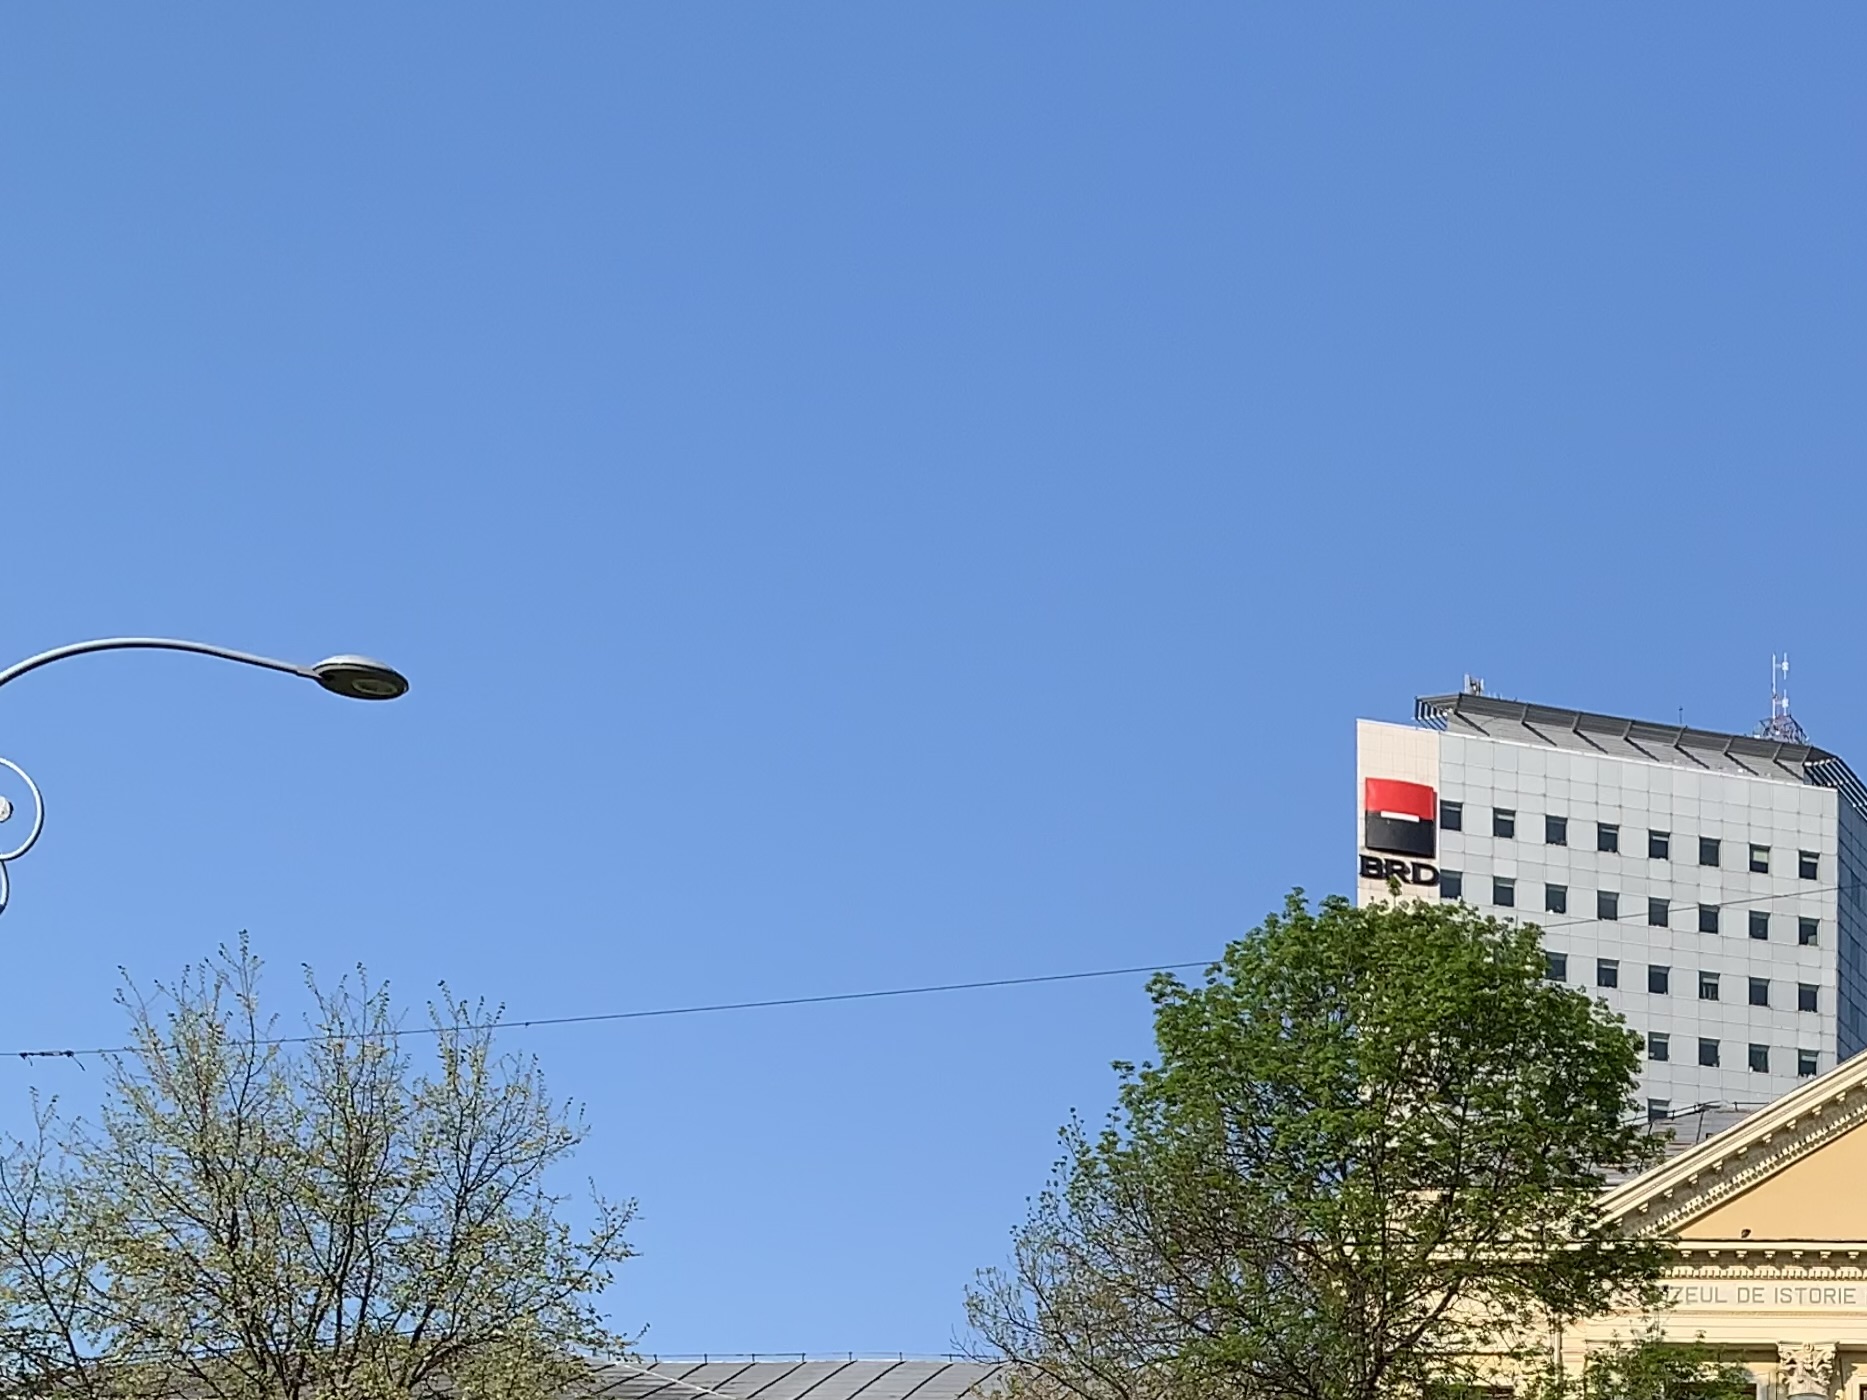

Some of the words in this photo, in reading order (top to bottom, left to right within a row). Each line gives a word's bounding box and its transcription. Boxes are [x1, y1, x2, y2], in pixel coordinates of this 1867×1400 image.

[1359, 854, 1440, 886] BRD
[1664, 1285, 1728, 1304] ZEUL
[1737, 1286, 1765, 1304] DE
[1774, 1287, 1857, 1305] ISTORIE
